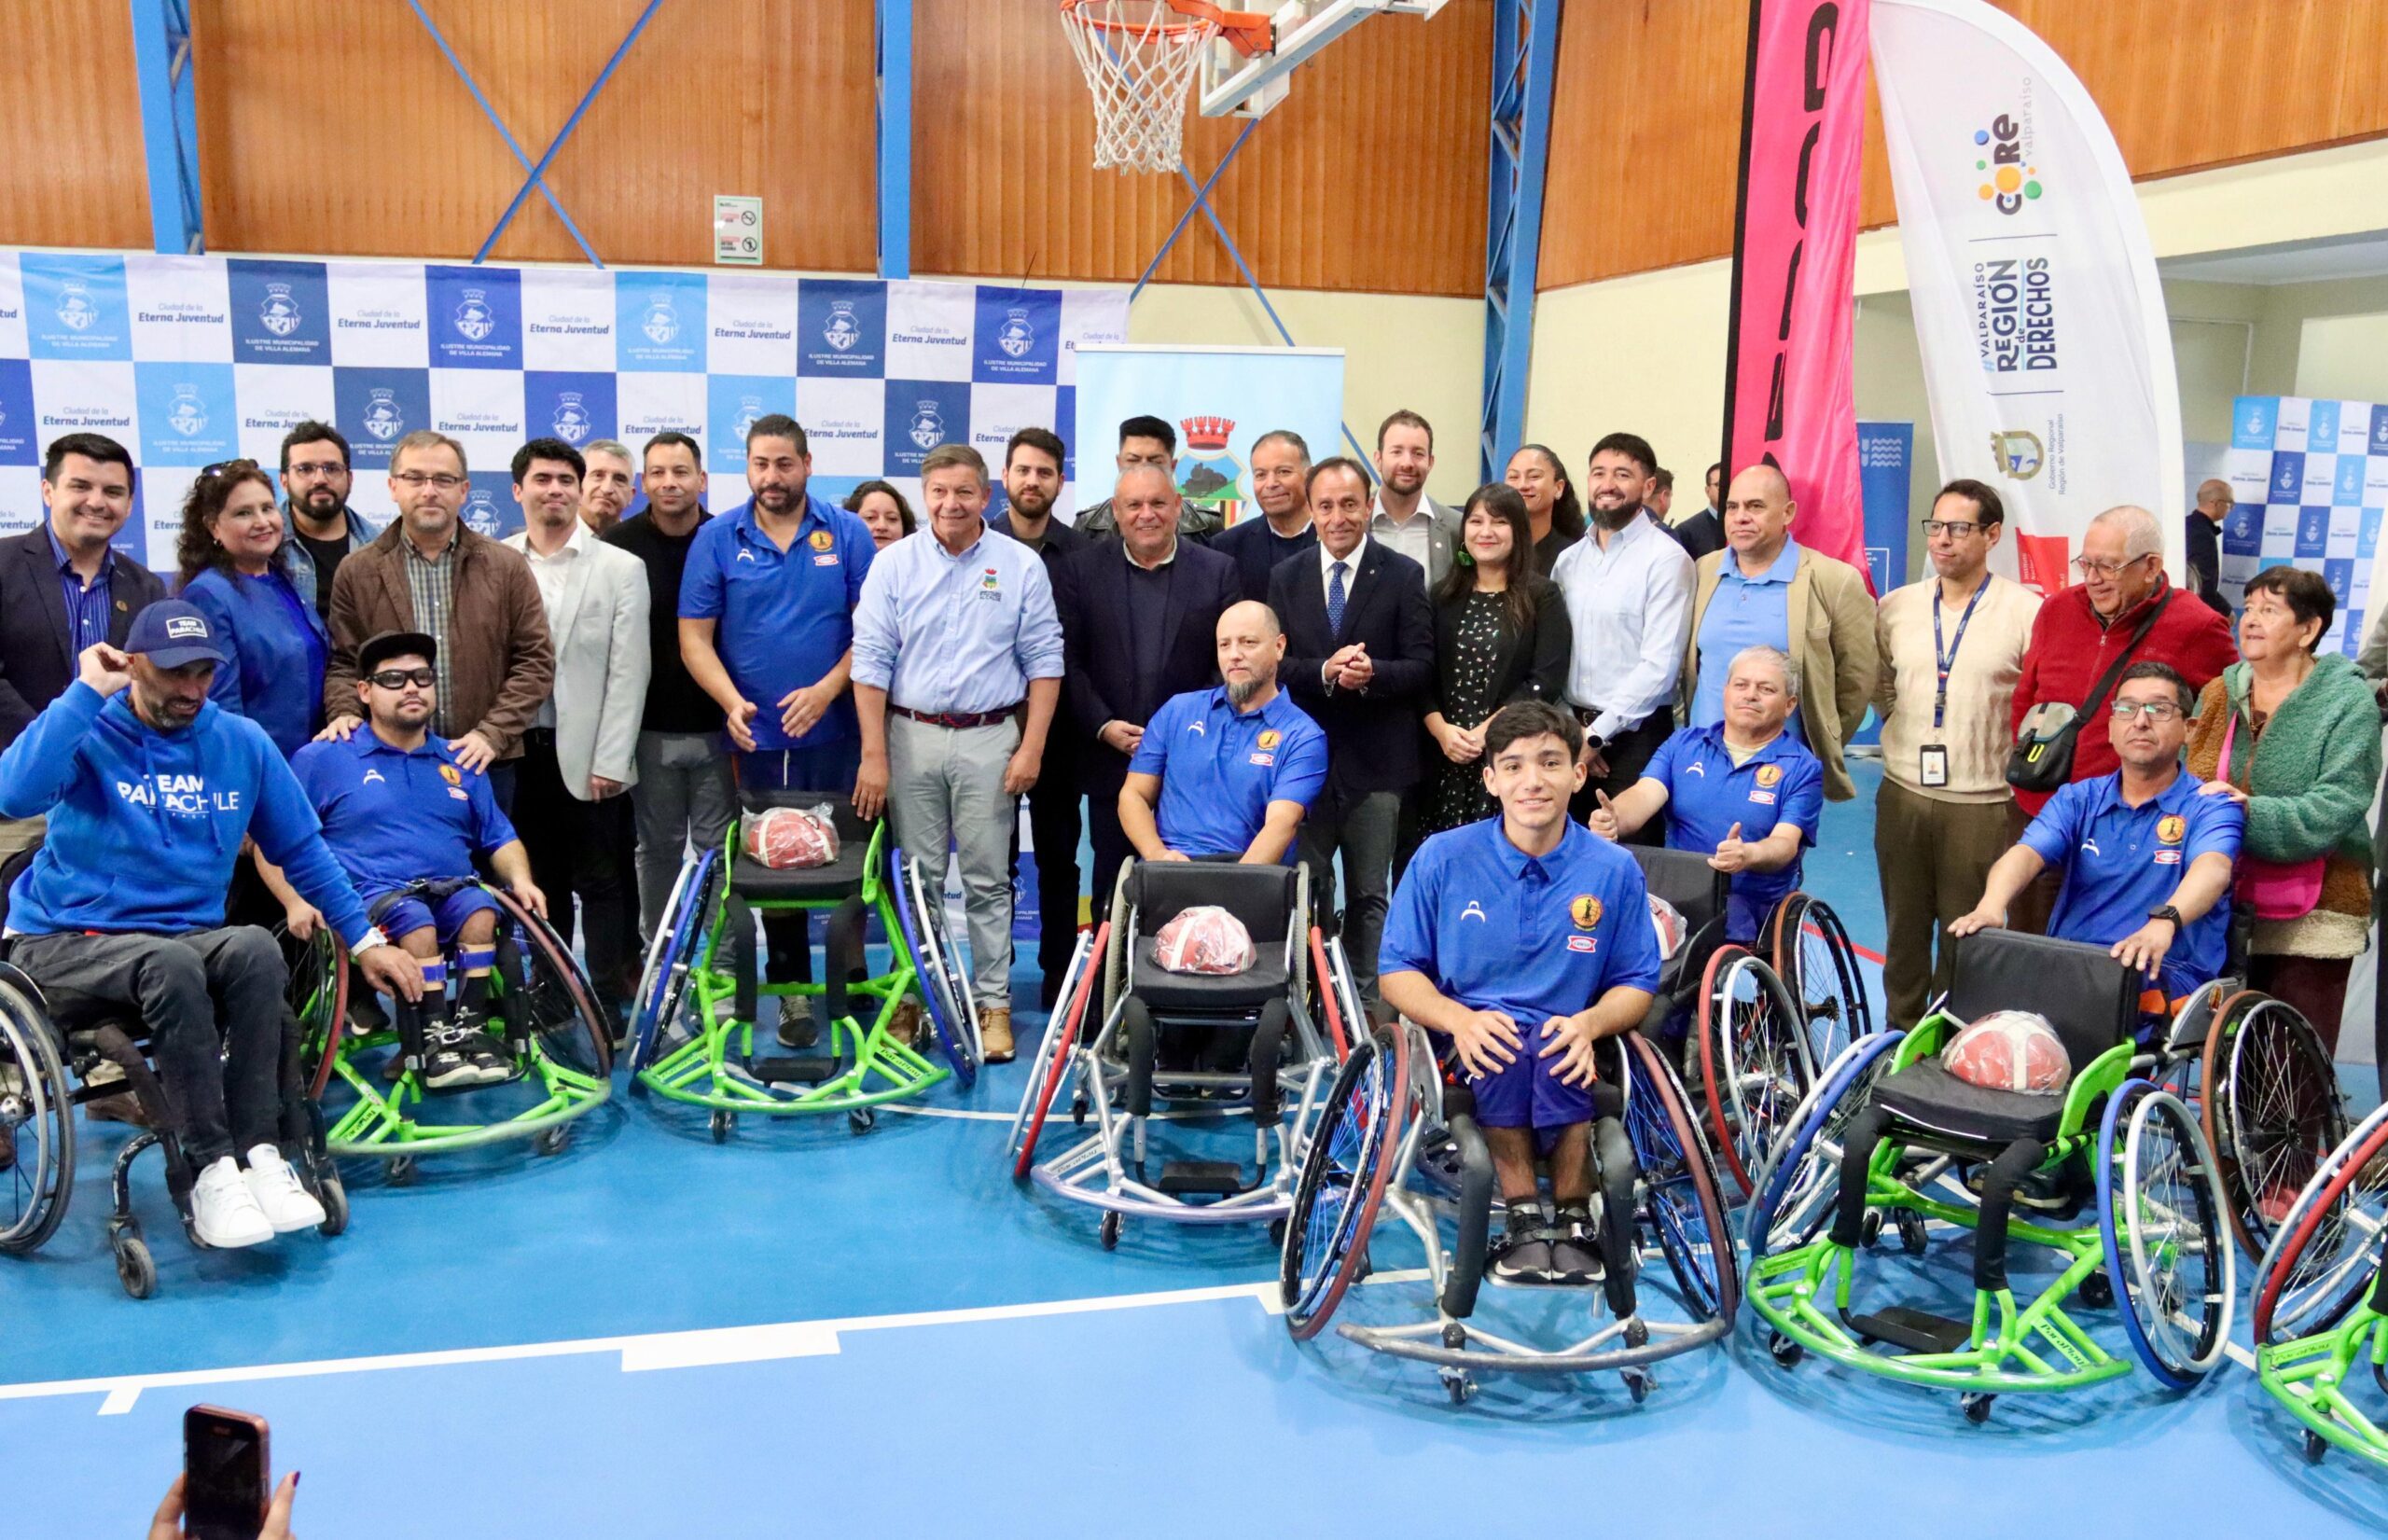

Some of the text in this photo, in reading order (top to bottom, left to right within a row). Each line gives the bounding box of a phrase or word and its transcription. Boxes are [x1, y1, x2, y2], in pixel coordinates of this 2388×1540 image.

[158, 302, 203, 312] Ciudad de la
[138, 312, 224, 324] Eterna Juventud
[357, 310, 382, 318] Ciudad
[383, 310, 393, 318] de
[1986, 259, 2020, 372] REGIÓN
[2026, 257, 2058, 370] DERECHOS
[338, 318, 420, 329] Eterna Juventud
[548, 315, 573, 324] Ciudad
[574, 315, 583, 324] de
[732, 320, 757, 328] Ciudad
[757, 320, 766, 328] de
[529, 323, 609, 335] Eterna Juventud
[715, 328, 791, 340] Eterna Juventud
[910, 326, 933, 334] Ciudad
[892, 333, 967, 345] Eterna Juventud
[2015, 327, 2025, 343] de
[62, 407, 109, 415] Ciudad de la
[265, 409, 290, 418] Ciudad
[292, 409, 301, 418] de
[43, 415, 130, 427] Eterna Juventud
[456, 413, 482, 422] Ciudad
[483, 413, 493, 422] de
[643, 416, 668, 424] Ciudad
[669, 416, 677, 424] de
[245, 419, 280, 429] Eterna
[438, 422, 518, 433] Eterna Juventud
[821, 420, 844, 428] Ciudad
[845, 420, 854, 428] de
[625, 424, 701, 435] Eterna Juventud
[804, 429, 878, 439] Eterna Juventud
[993, 425, 1015, 434] Ciudad
[976, 434, 1005, 444] Eterna
[2058, 455, 2065, 465] de
[0, 520, 36, 529] ventud
